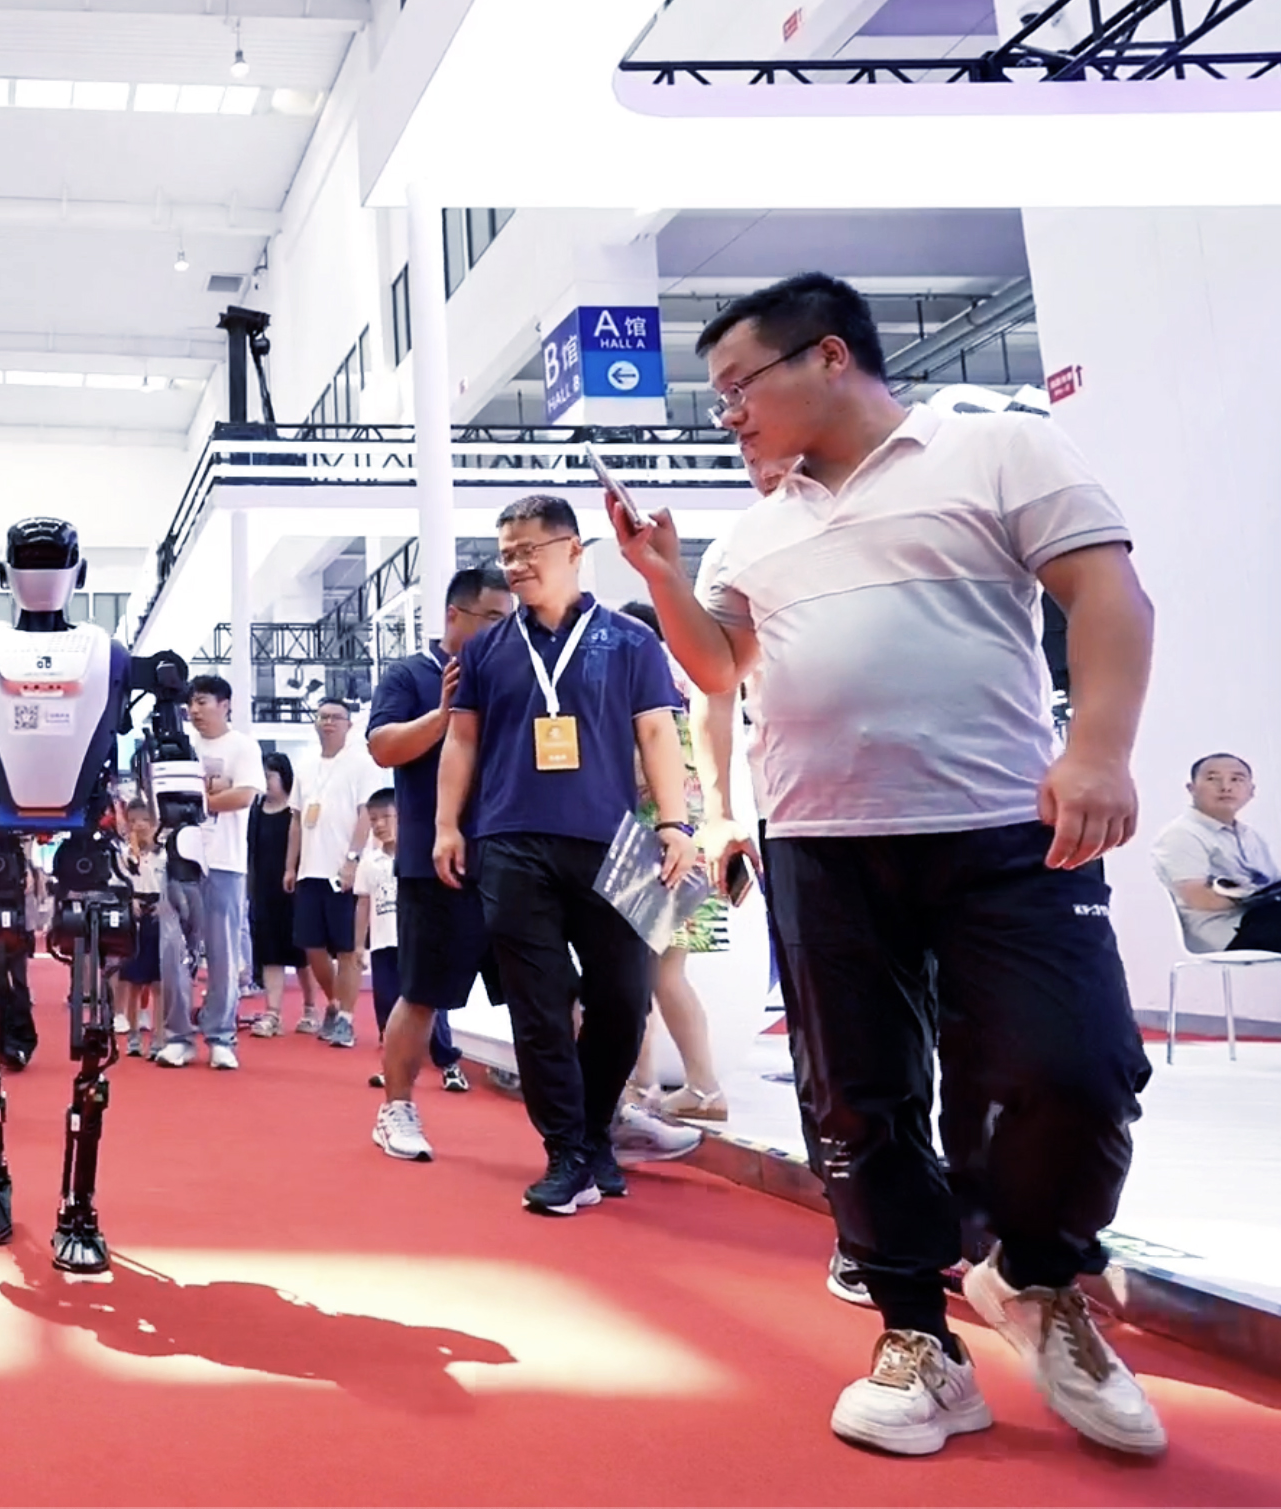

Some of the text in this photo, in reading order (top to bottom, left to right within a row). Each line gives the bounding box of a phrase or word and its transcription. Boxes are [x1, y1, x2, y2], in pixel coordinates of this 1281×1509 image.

[600, 338, 646, 349] HALL A
[547, 374, 579, 413] HALL B
